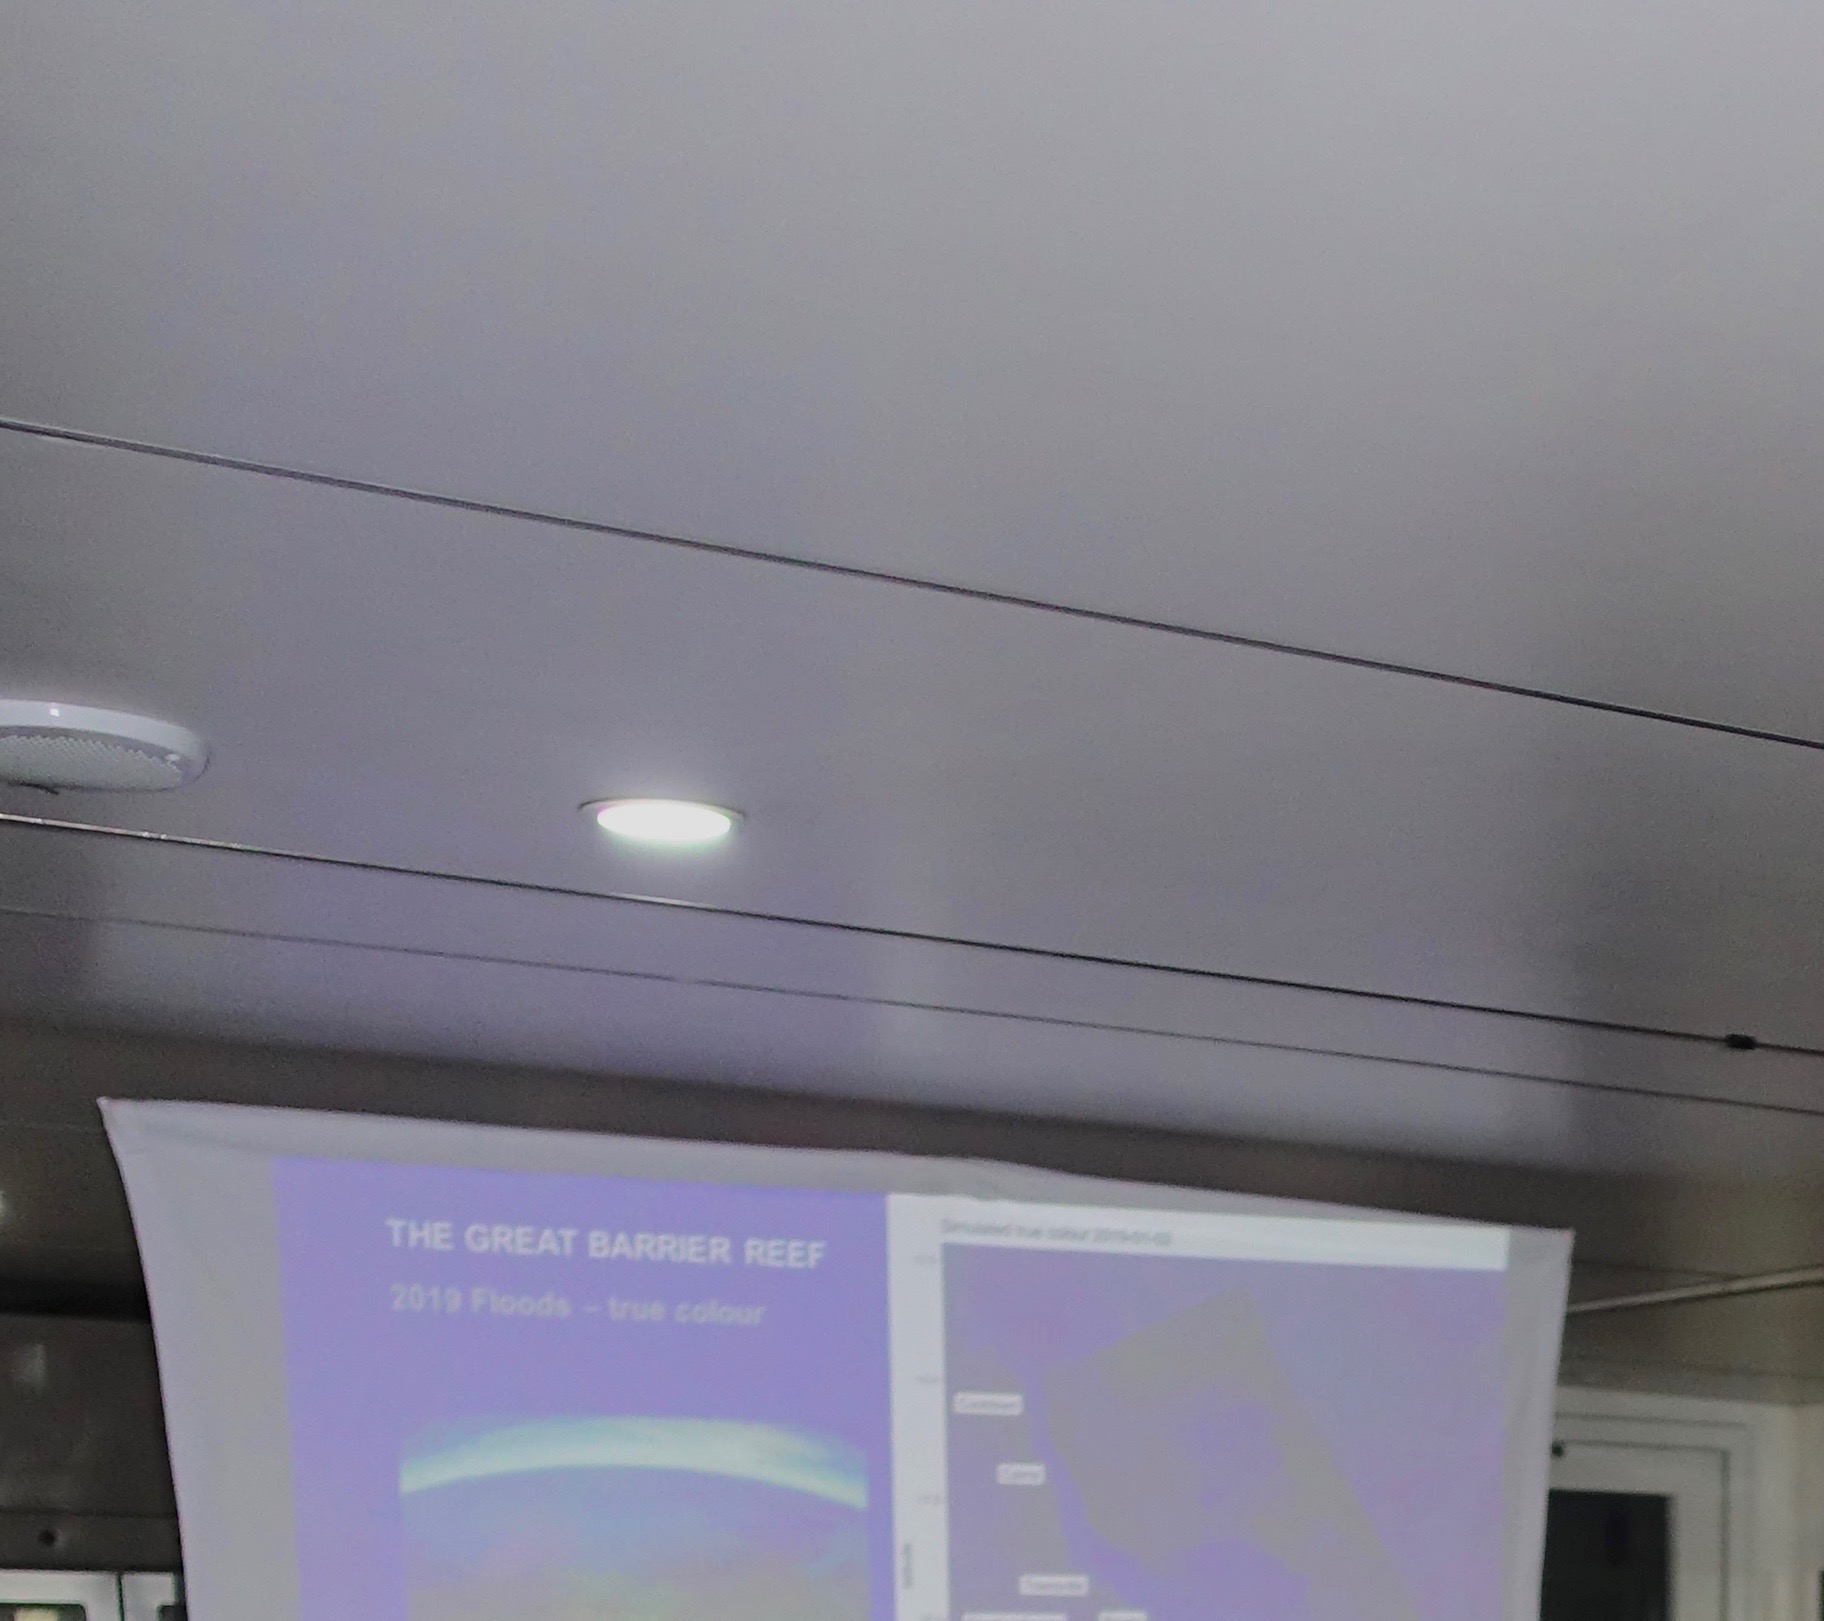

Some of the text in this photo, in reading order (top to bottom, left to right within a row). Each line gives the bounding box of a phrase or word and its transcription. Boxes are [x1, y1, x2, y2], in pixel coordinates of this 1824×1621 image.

[386, 1218, 828, 1269] THE GREAT BARRIER REEF
[391, 1283, 462, 1313] 2019
[471, 1287, 572, 1319] Floods
[608, 1297, 665, 1323] true
[675, 1300, 766, 1326] colour
